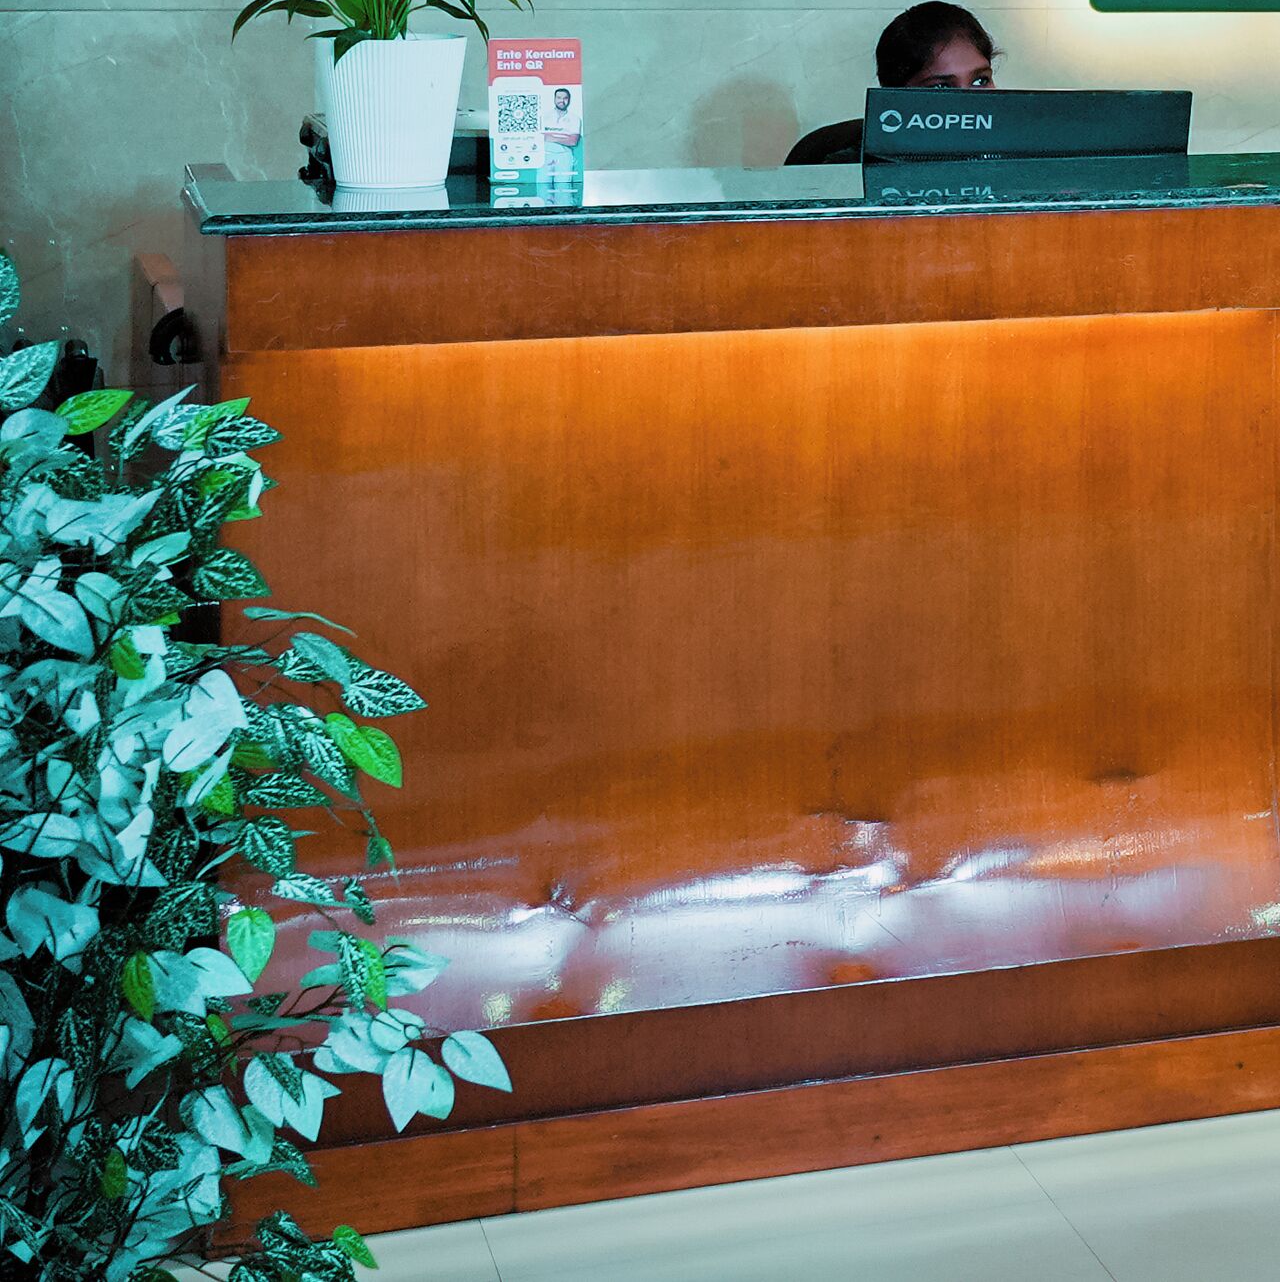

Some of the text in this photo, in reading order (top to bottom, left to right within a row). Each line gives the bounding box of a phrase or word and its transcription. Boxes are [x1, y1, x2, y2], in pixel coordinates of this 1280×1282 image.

[496, 49, 575, 60] Ente Keralam
[496, 60, 544, 70] Ente QR
[906, 114, 993, 130] AOPEN
